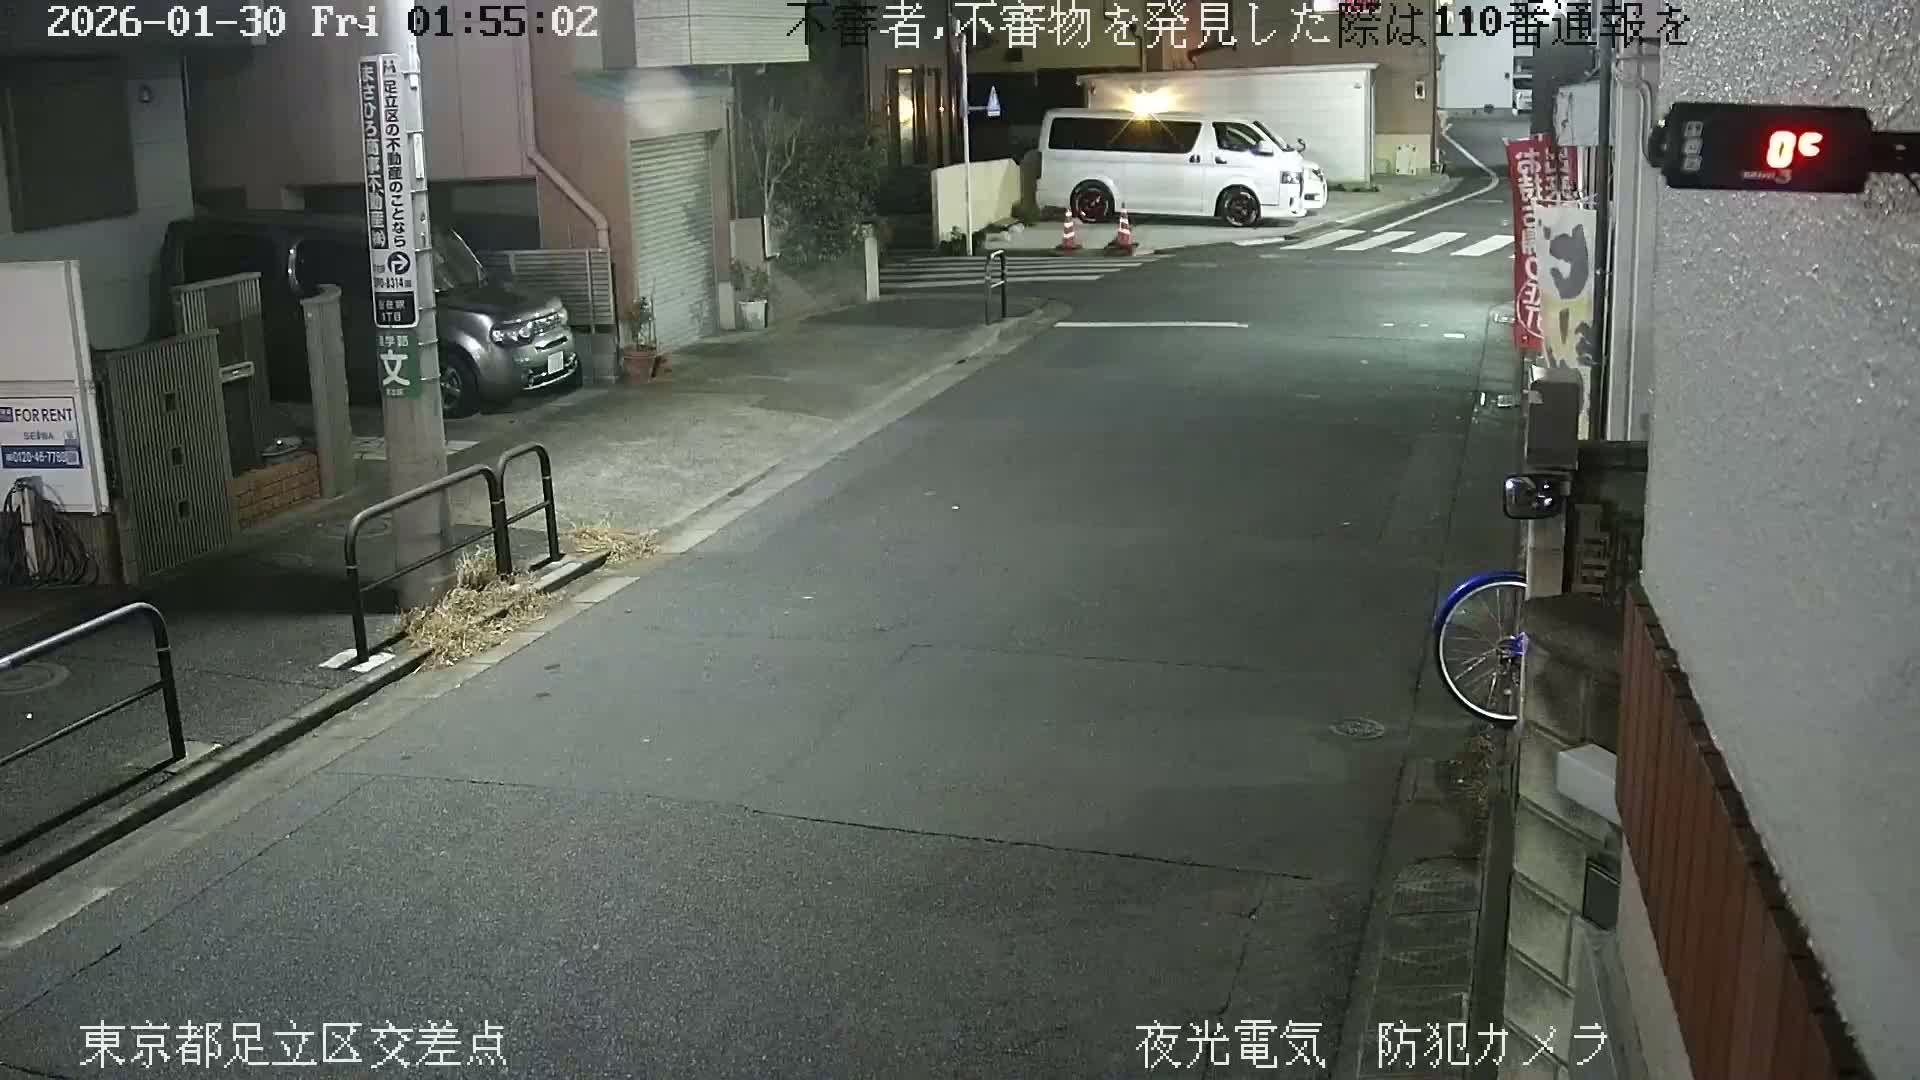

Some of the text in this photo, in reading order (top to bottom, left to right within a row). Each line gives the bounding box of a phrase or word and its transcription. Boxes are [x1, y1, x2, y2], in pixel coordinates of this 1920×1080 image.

[384, 80, 406, 248] 足立区の不動産のことなら
[379, 349, 411, 386] 文
[14, 408, 40, 422] FOR
[41, 408, 73, 422] RENT
